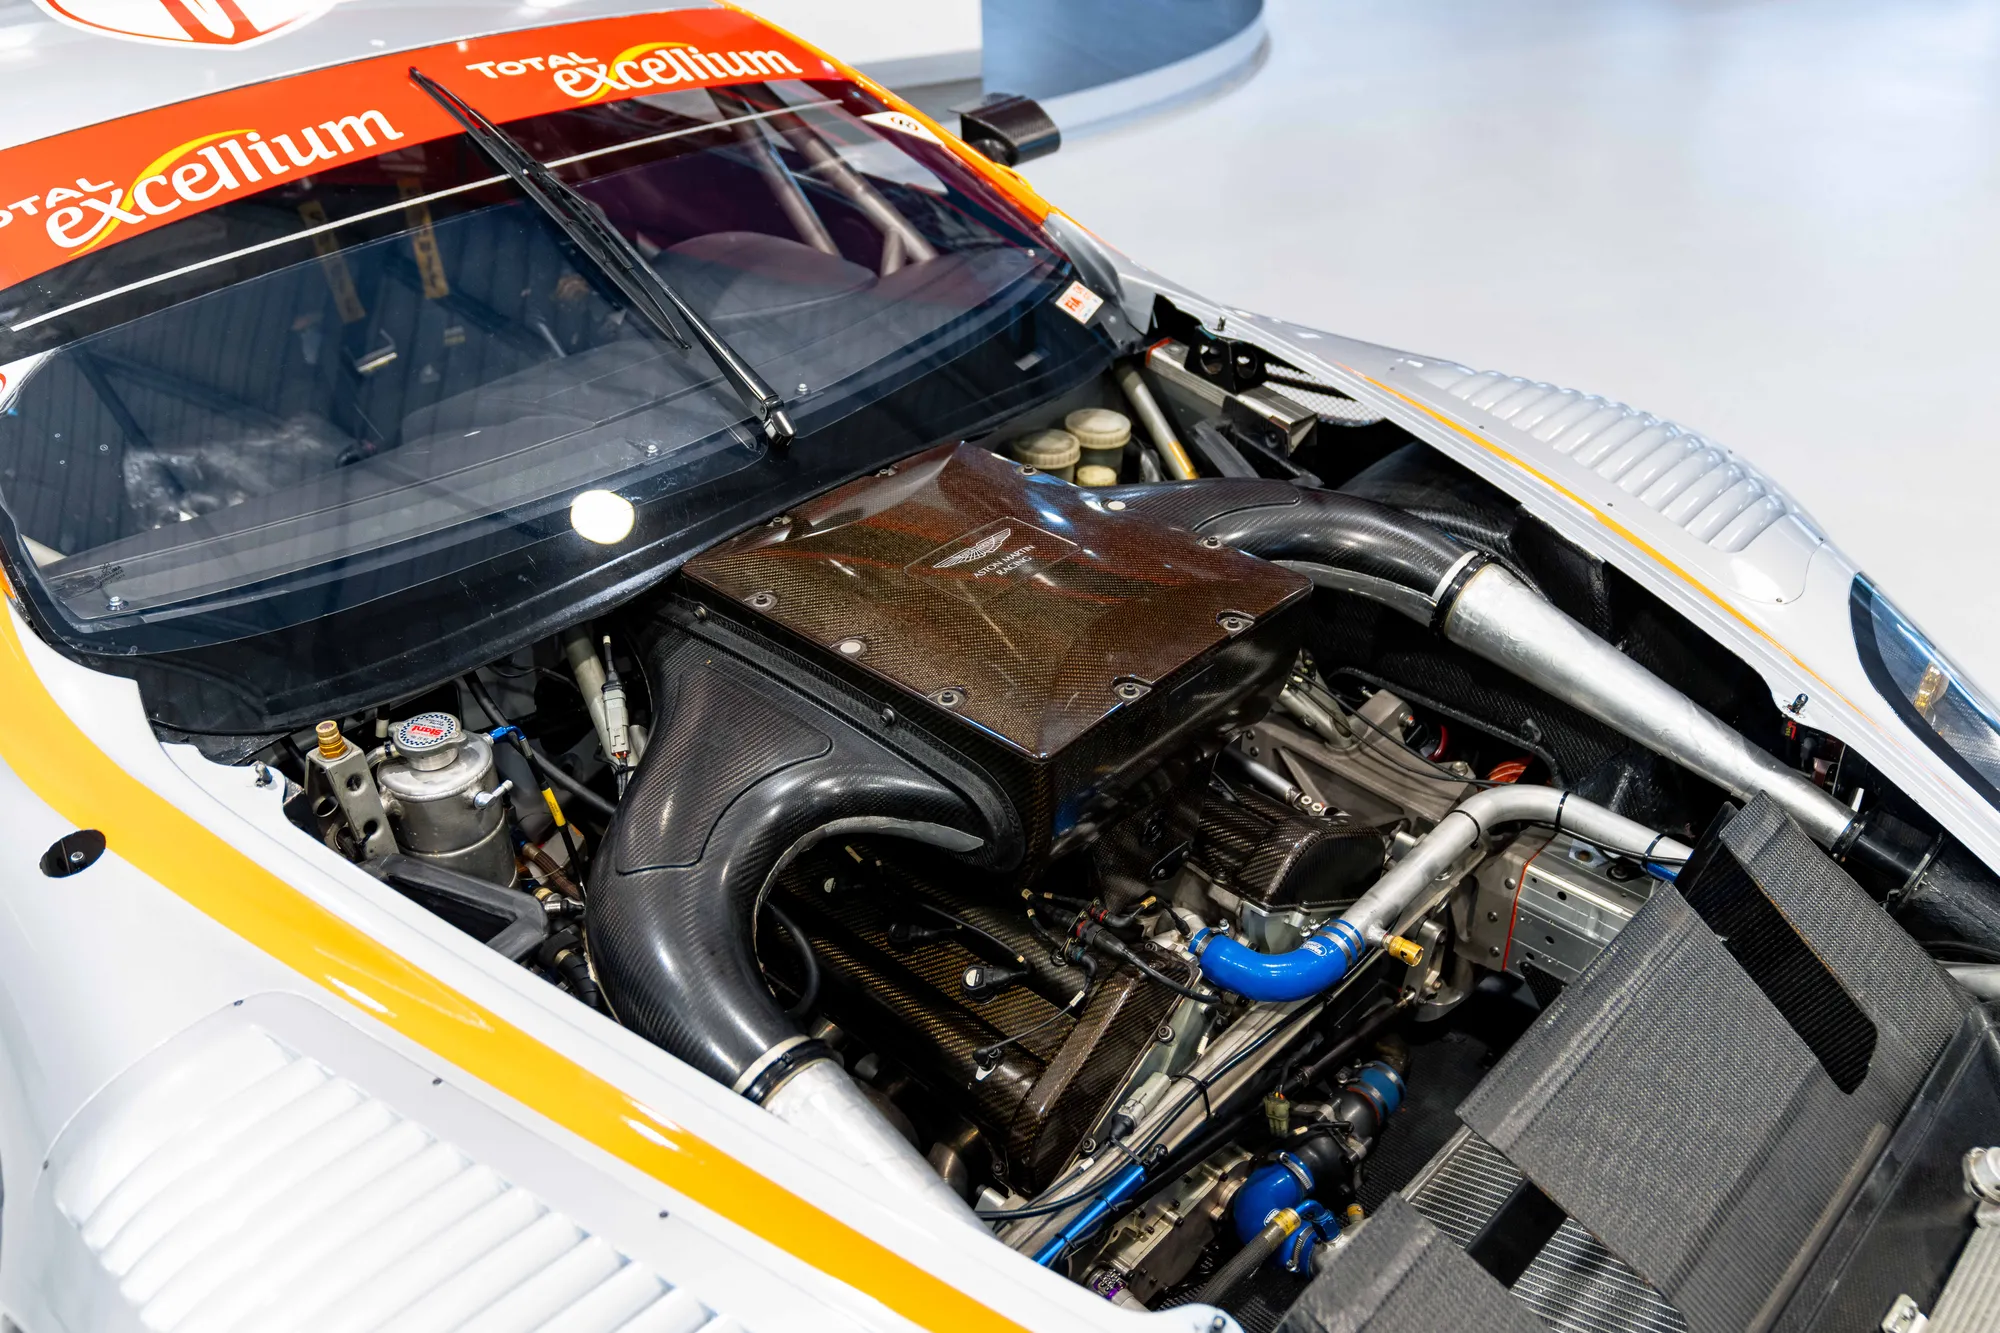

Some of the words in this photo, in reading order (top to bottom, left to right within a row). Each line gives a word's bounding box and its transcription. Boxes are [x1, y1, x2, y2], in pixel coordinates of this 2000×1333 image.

[465, 51, 599, 79] TOTAL
[553, 46, 803, 98] excellium
[45, 109, 404, 248] excellium
[973, 560, 1003, 579] ASTON
[1002, 544, 1036, 563] MARTIN
[996, 556, 1033, 576] RACING
[411, 725, 444, 736] Stant
